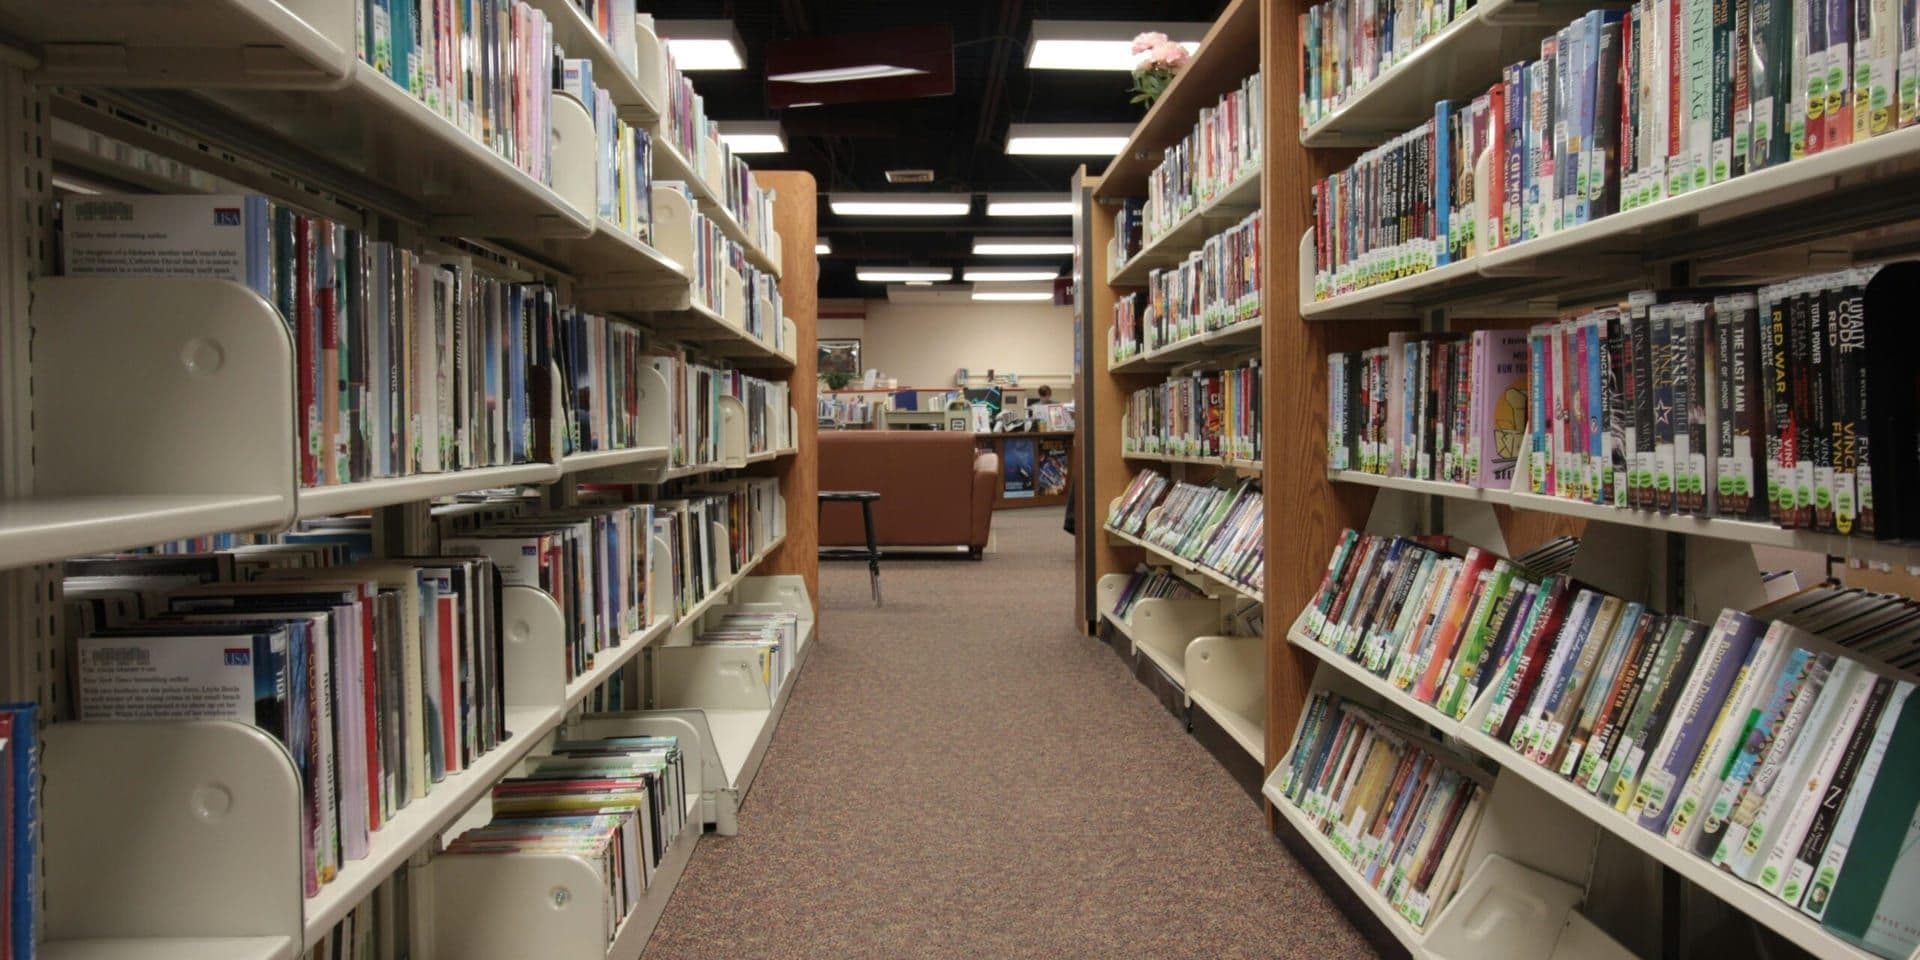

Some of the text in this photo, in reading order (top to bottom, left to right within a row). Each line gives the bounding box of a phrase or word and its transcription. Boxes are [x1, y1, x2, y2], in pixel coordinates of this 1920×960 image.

[216, 211, 240, 226] USA
[1720, 328, 1728, 364] PURSUIT
[1796, 301, 1807, 360] LETHAL
[1810, 302, 1822, 364] TOTAL POWER
[1828, 310, 1838, 347] RED
[1839, 300, 1853, 354] CODE
[1660, 344, 1672, 386] VINCE
[1720, 366, 1728, 377] OF
[1734, 328, 1745, 412] THE LAST MAN
[1772, 310, 1787, 393] RED WAR
[1860, 368, 1867, 377] BY
[1600, 344, 1608, 412] VINCE FLYNN
[1720, 381, 1728, 409] HONOR
[1722, 420, 1730, 443] VINCE
[1801, 428, 1810, 462] VINC
[1821, 437, 1829, 467] VINC
[1784, 438, 1793, 469] VINC
[224, 651, 250, 666] USA
[1502, 653, 1532, 700] NEVER
[1702, 639, 1732, 685] BROKEN
[276, 665, 286, 703] TIDE
[308, 653, 318, 713] CLOSE
[1611, 662, 1640, 708] FORSYTH
[311, 716, 320, 764] CALL
[323, 672, 334, 811] HEART GRIFFIN
[1757, 687, 1812, 785] BLACK GLASS
[1822, 784, 1843, 809] Z
